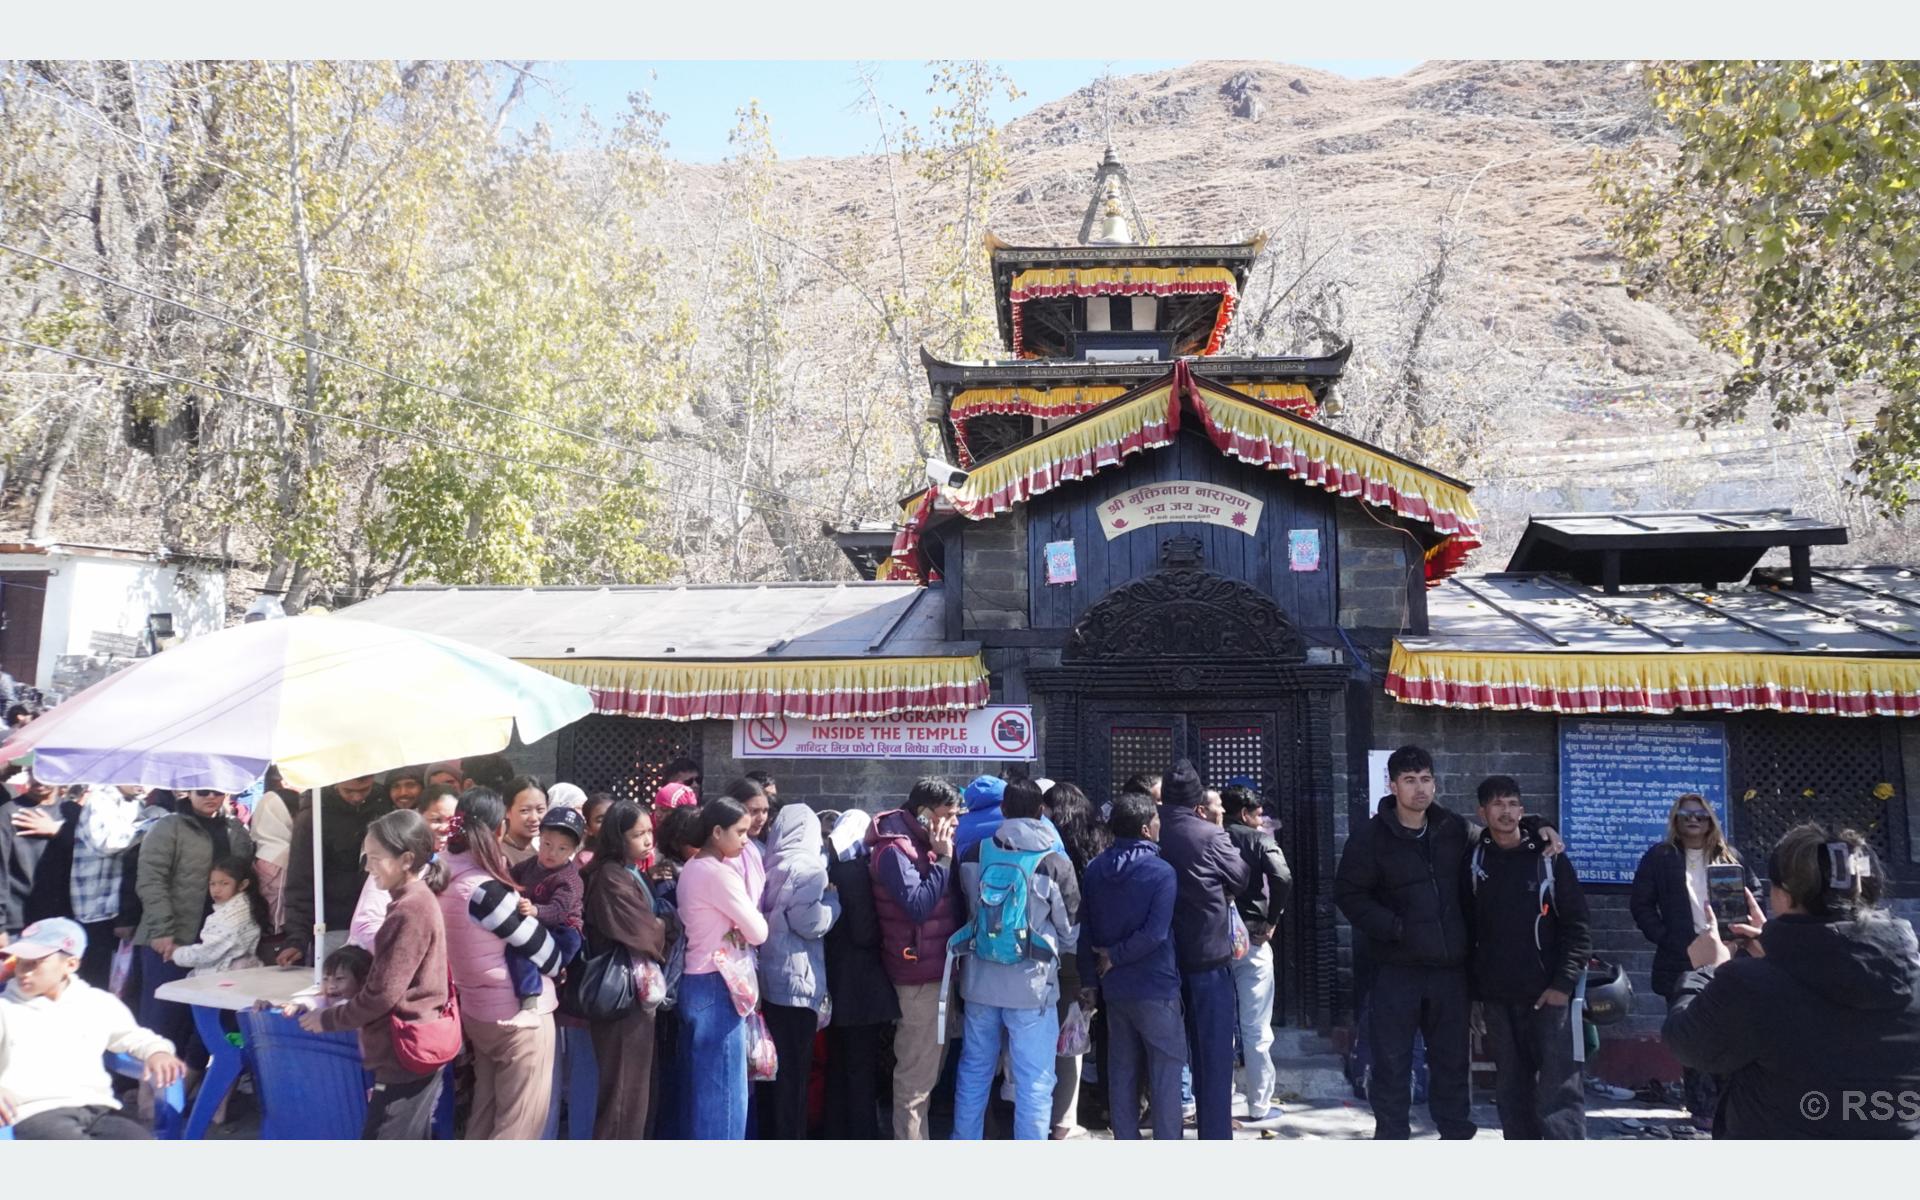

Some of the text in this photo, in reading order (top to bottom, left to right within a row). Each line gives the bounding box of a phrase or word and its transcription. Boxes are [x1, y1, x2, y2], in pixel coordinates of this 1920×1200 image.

[1108, 486, 1251, 515] श्री मुक्तिनाथ नारायण
[1143, 502, 1221, 515] जय जय जय
[812, 727, 968, 740] INSIDE THE TEMPLE
[852, 741, 874, 753] फोटो
[877, 741, 902, 754] खिच्न
[905, 741, 929, 754] निषेध
[931, 742, 967, 754] गरिएको
[970, 745, 980, 754] छ
[1577, 870, 1616, 880] INSIDE
